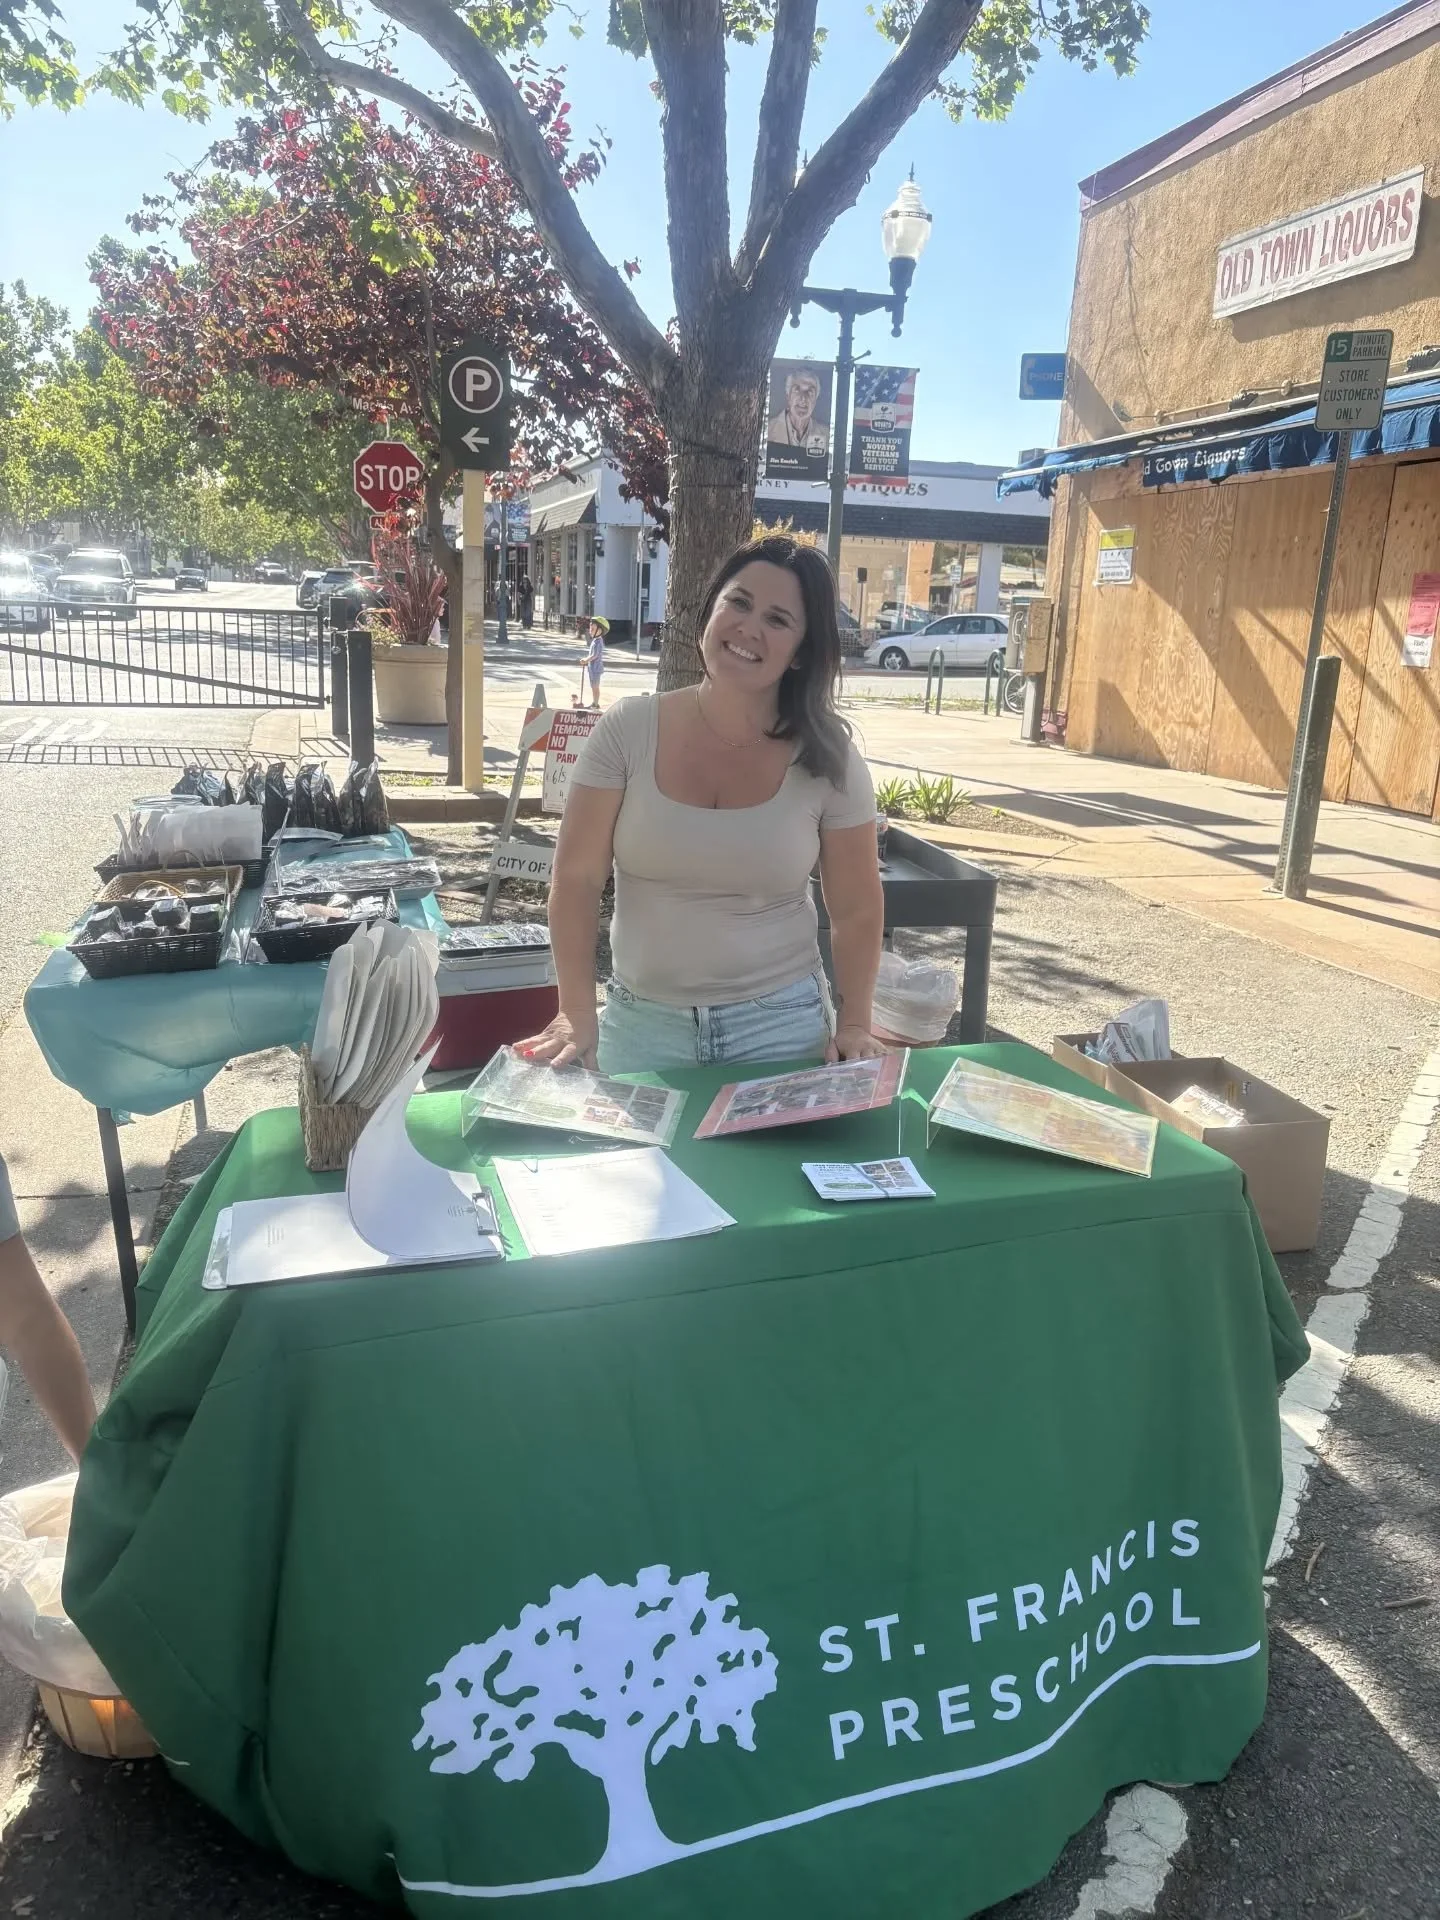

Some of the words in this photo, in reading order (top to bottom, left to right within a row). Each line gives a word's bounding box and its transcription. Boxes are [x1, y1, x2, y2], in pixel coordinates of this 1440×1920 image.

[1219, 248, 1254, 300] OLD
[1260, 224, 1316, 287] TOWN
[1319, 187, 1416, 269] LIQUORS
[1356, 335, 1386, 345] MINUTE
[1330, 339, 1349, 356] 15
[1352, 345, 1387, 357] PARKING
[1030, 372, 1065, 381] PHONE
[1339, 369, 1370, 382] STORE
[465, 367, 492, 402] P
[1323, 388, 1380, 402] CUSTOMERS
[1335, 407, 1362, 420] ONLY
[861, 436, 888, 444] THANK
[888, 437, 903, 445] YOU
[866, 443, 896, 451] NOVATO
[862, 450, 899, 458] VETERANS
[1156, 457, 1189, 473] Town
[1194, 446, 1247, 468] Liquors
[864, 464, 895, 472] SERVICE
[360, 464, 420, 491] STOP
[551, 735, 566, 748] NO
[497, 856, 526, 871] CITY
[528, 861, 547, 873] OF
[818, 1613, 926, 1673] ST.
[966, 1518, 1200, 1643] FRANCIS
[828, 1587, 1201, 1761] PRESCHOOL
